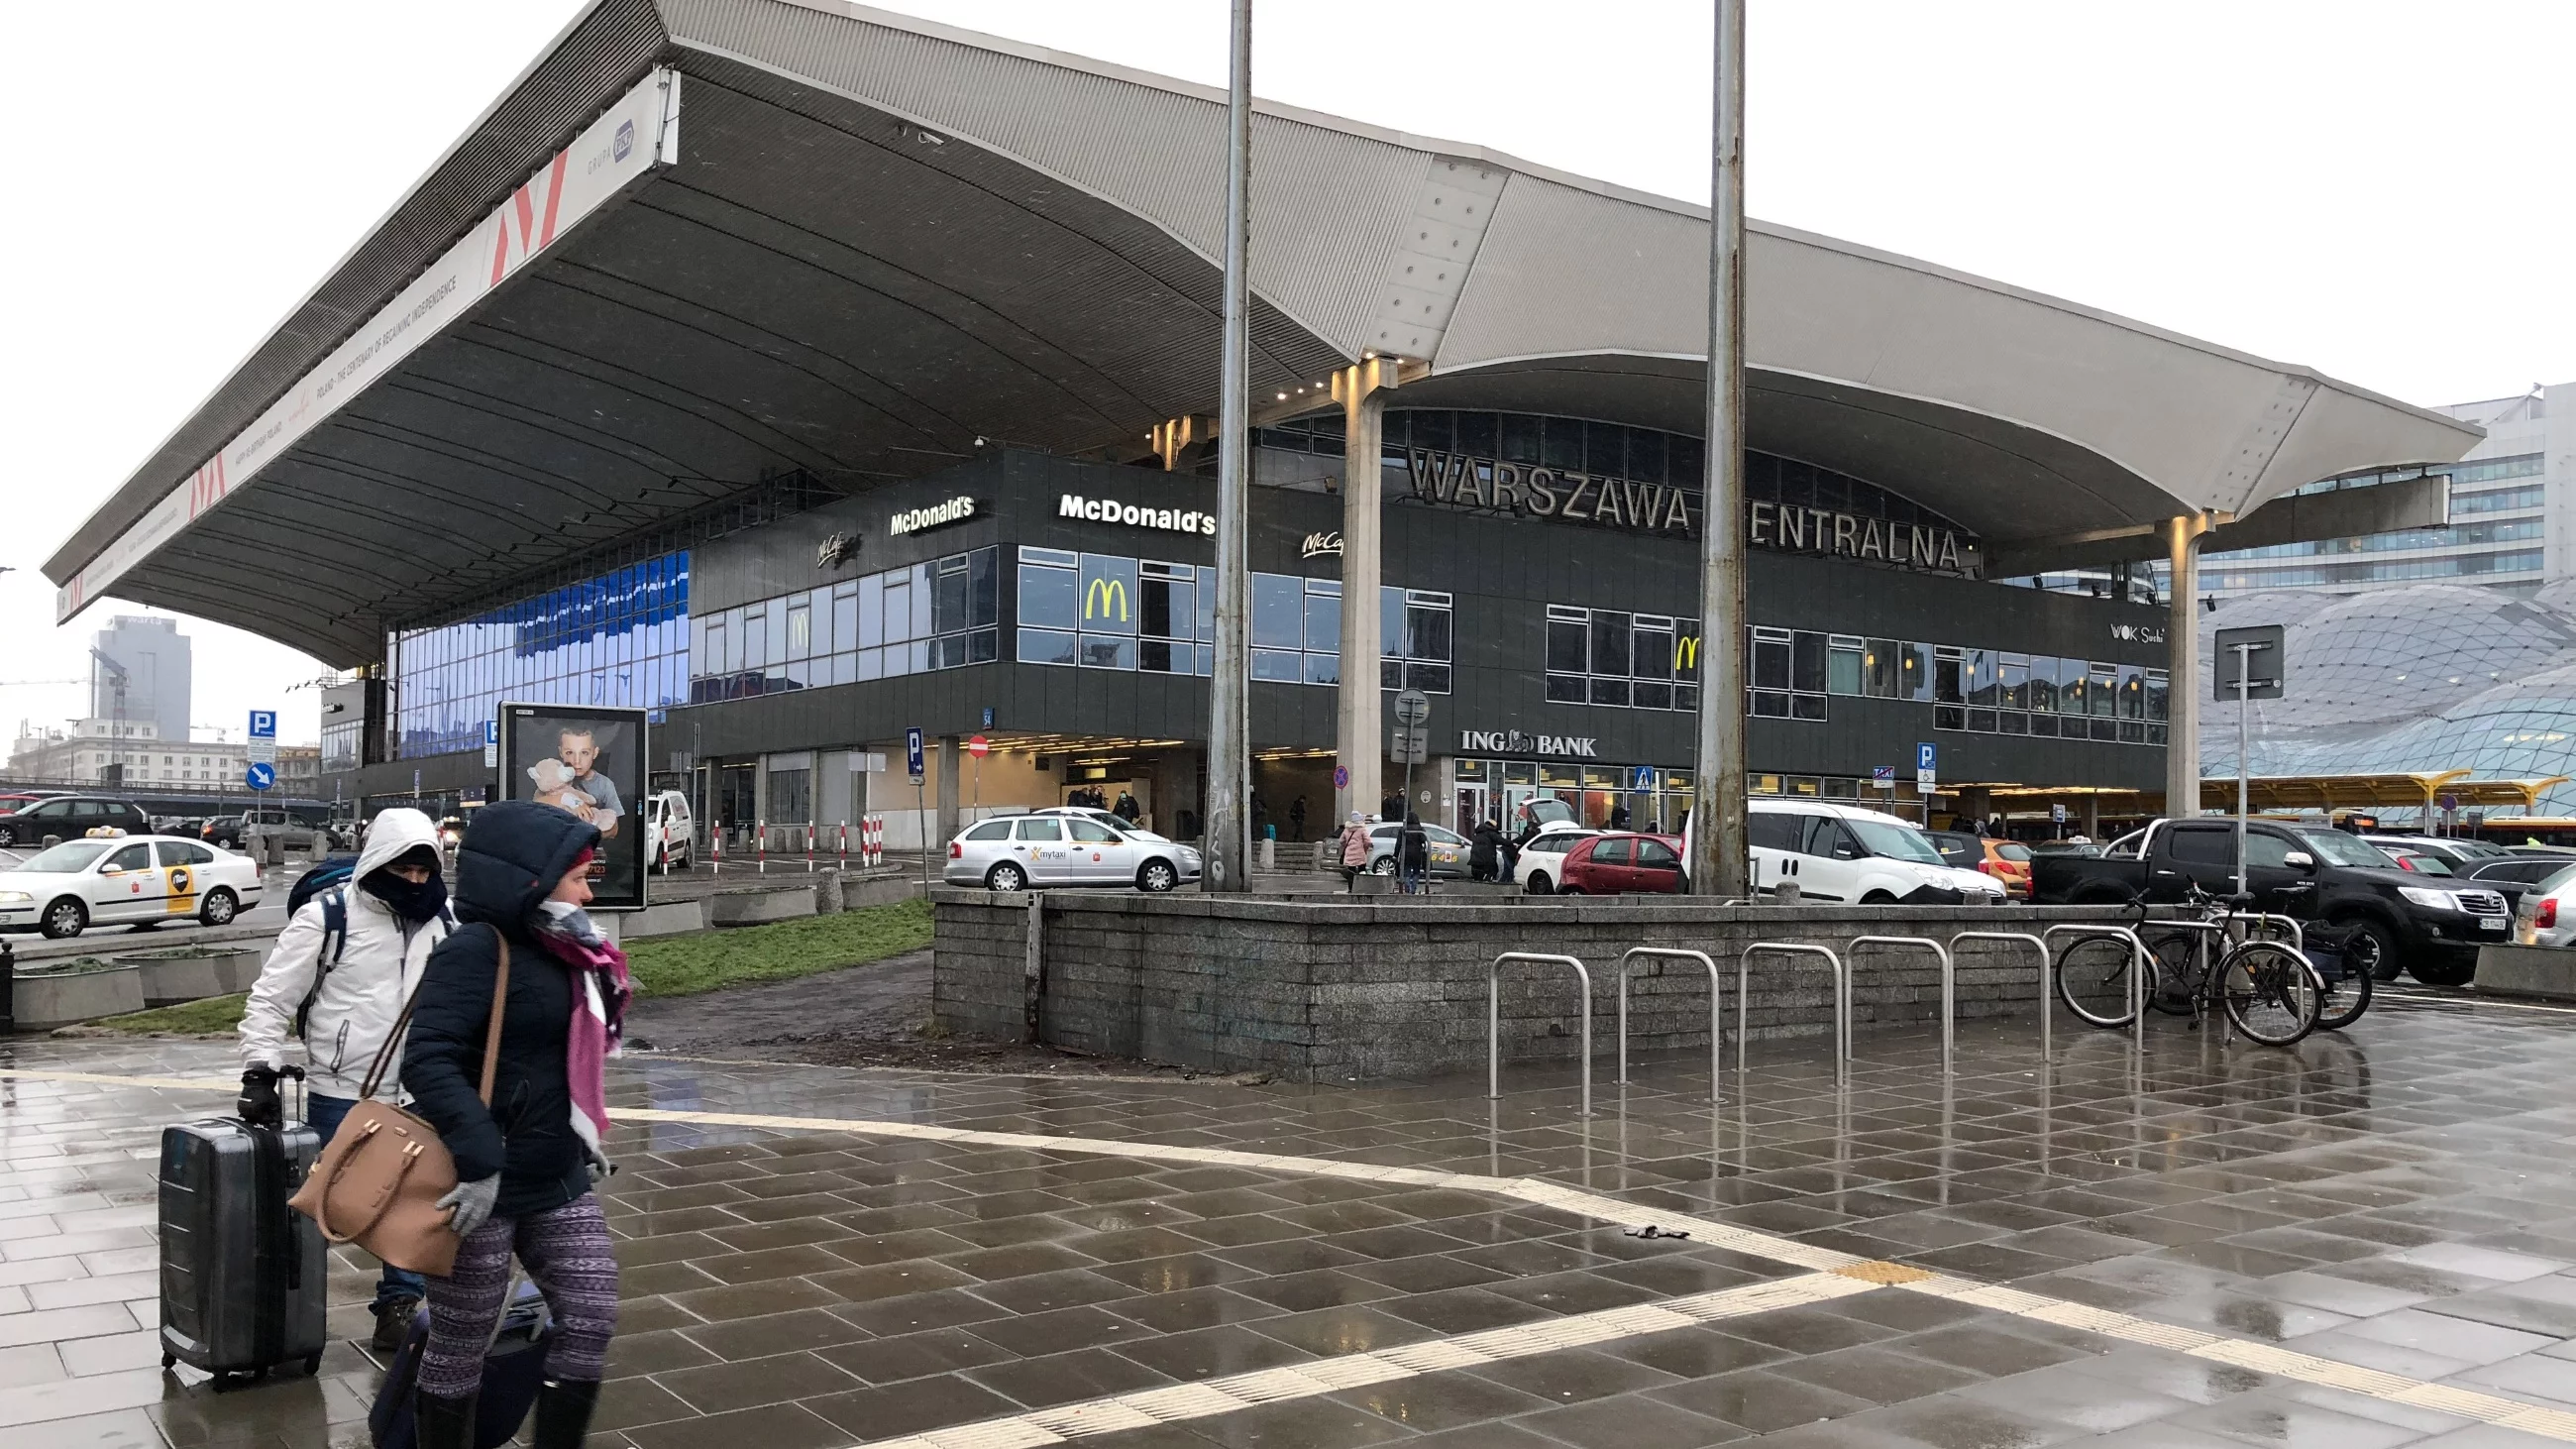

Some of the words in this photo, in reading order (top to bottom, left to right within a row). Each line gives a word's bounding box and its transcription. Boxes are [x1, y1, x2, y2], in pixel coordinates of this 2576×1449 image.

[589, 147, 610, 174] GRUPA
[615, 130, 632, 153] PKP
[347, 347, 374, 377] CENTENARY
[375, 337, 381, 353] OF
[382, 313, 410, 349] REGAINING
[411, 275, 456, 324] INDEPENDENCE
[1407, 447, 1689, 530] WARSZAWA
[891, 497, 974, 536] McDonald's
[1059, 495, 1216, 535] McDonald's
[1301, 531, 1343, 558] McCa
[1750, 502, 1960, 568] ENTRALNA
[2109, 623, 2138, 641] WOK
[2140, 626, 2165, 643] Sushi
[254, 713, 271, 733] P
[984, 715, 991, 725] 54
[909, 732, 920, 762] P
[1461, 730, 1506, 751] ING
[1537, 735, 1597, 757] BANK
[1921, 745, 1933, 767] P
[1874, 768, 1893, 778] TAXI
[1039, 849, 1066, 860] mytaxi
